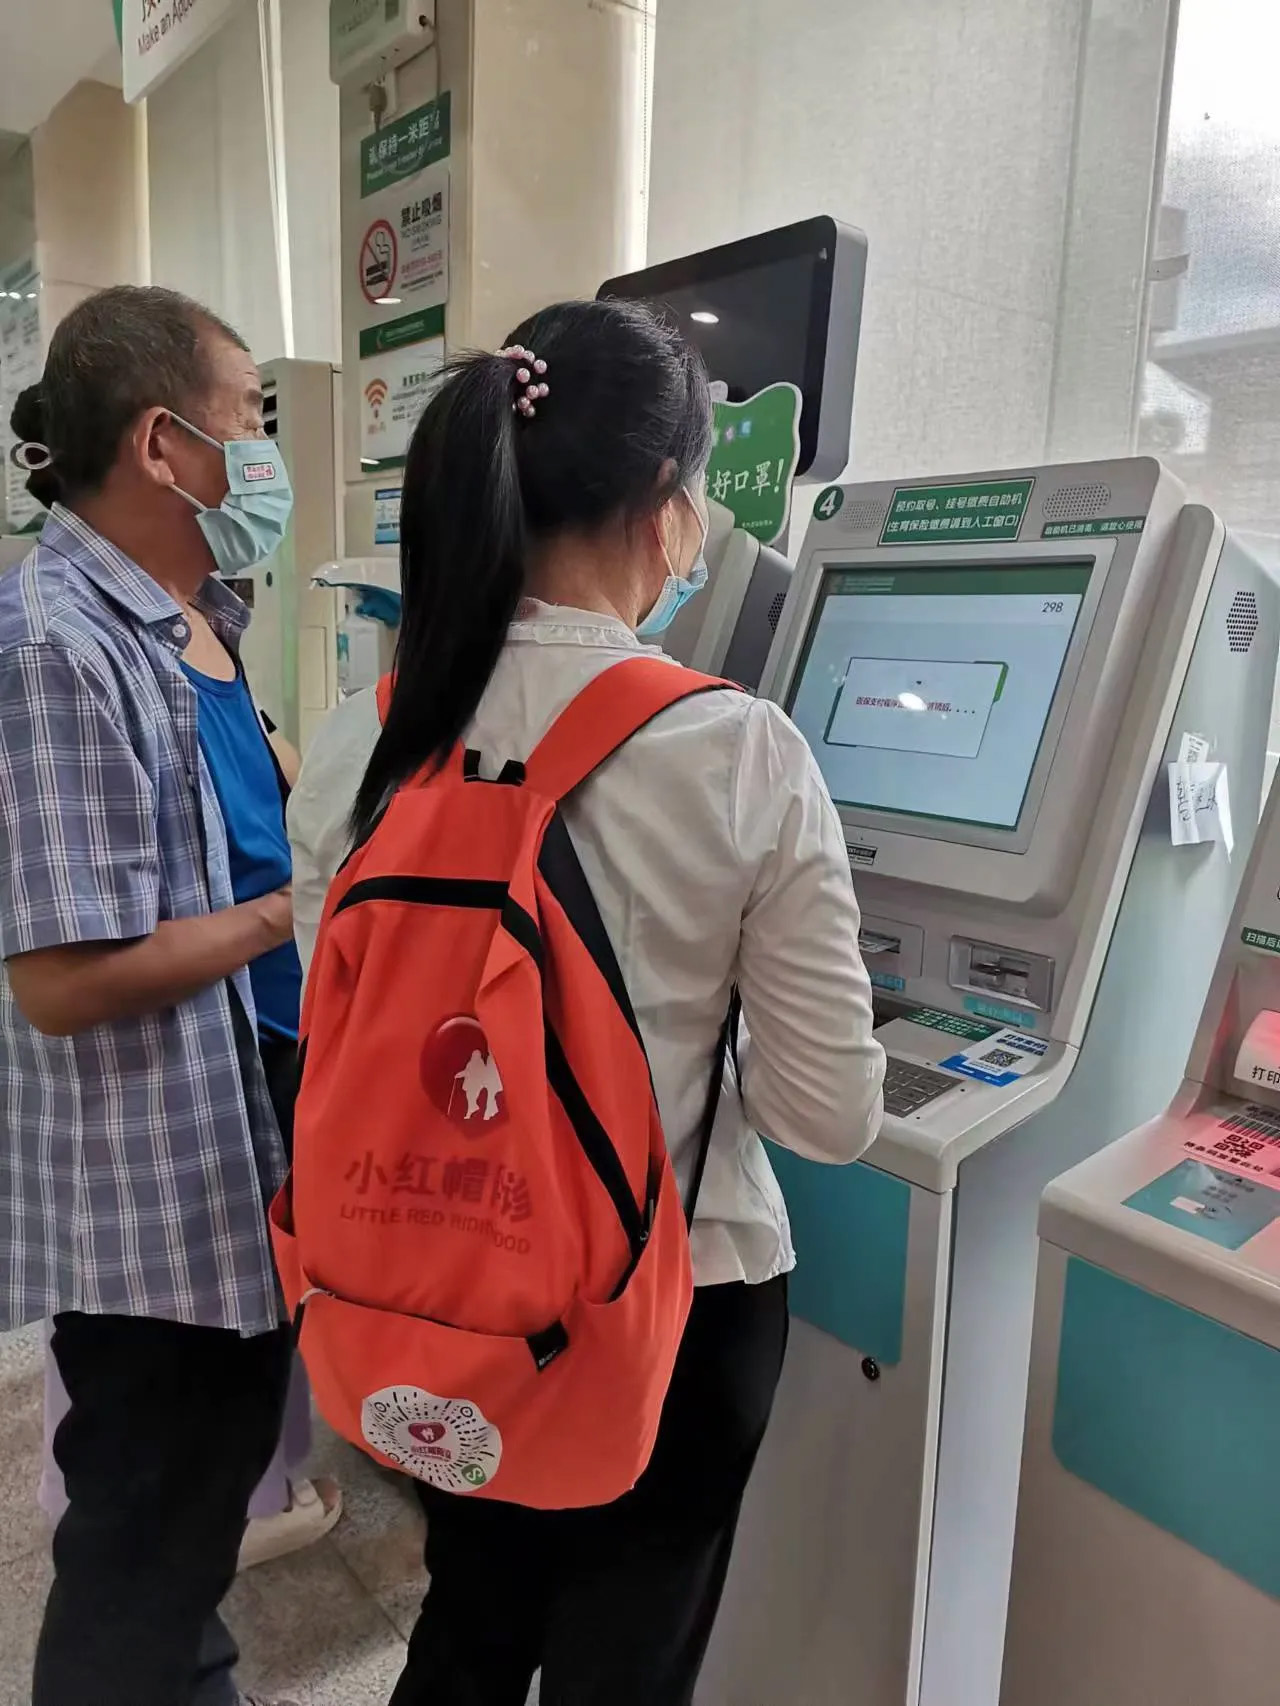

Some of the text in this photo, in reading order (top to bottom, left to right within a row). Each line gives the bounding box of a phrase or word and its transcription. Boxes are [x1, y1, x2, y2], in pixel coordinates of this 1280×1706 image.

[706, 458, 784, 501] 好口罩!
[819, 490, 837, 516] 4
[1042, 602, 1063, 613] 298
[1252, 1066, 1280, 1085] 打印
[340, 1204, 401, 1225] LITTLE
[407, 1208, 445, 1226] RED
